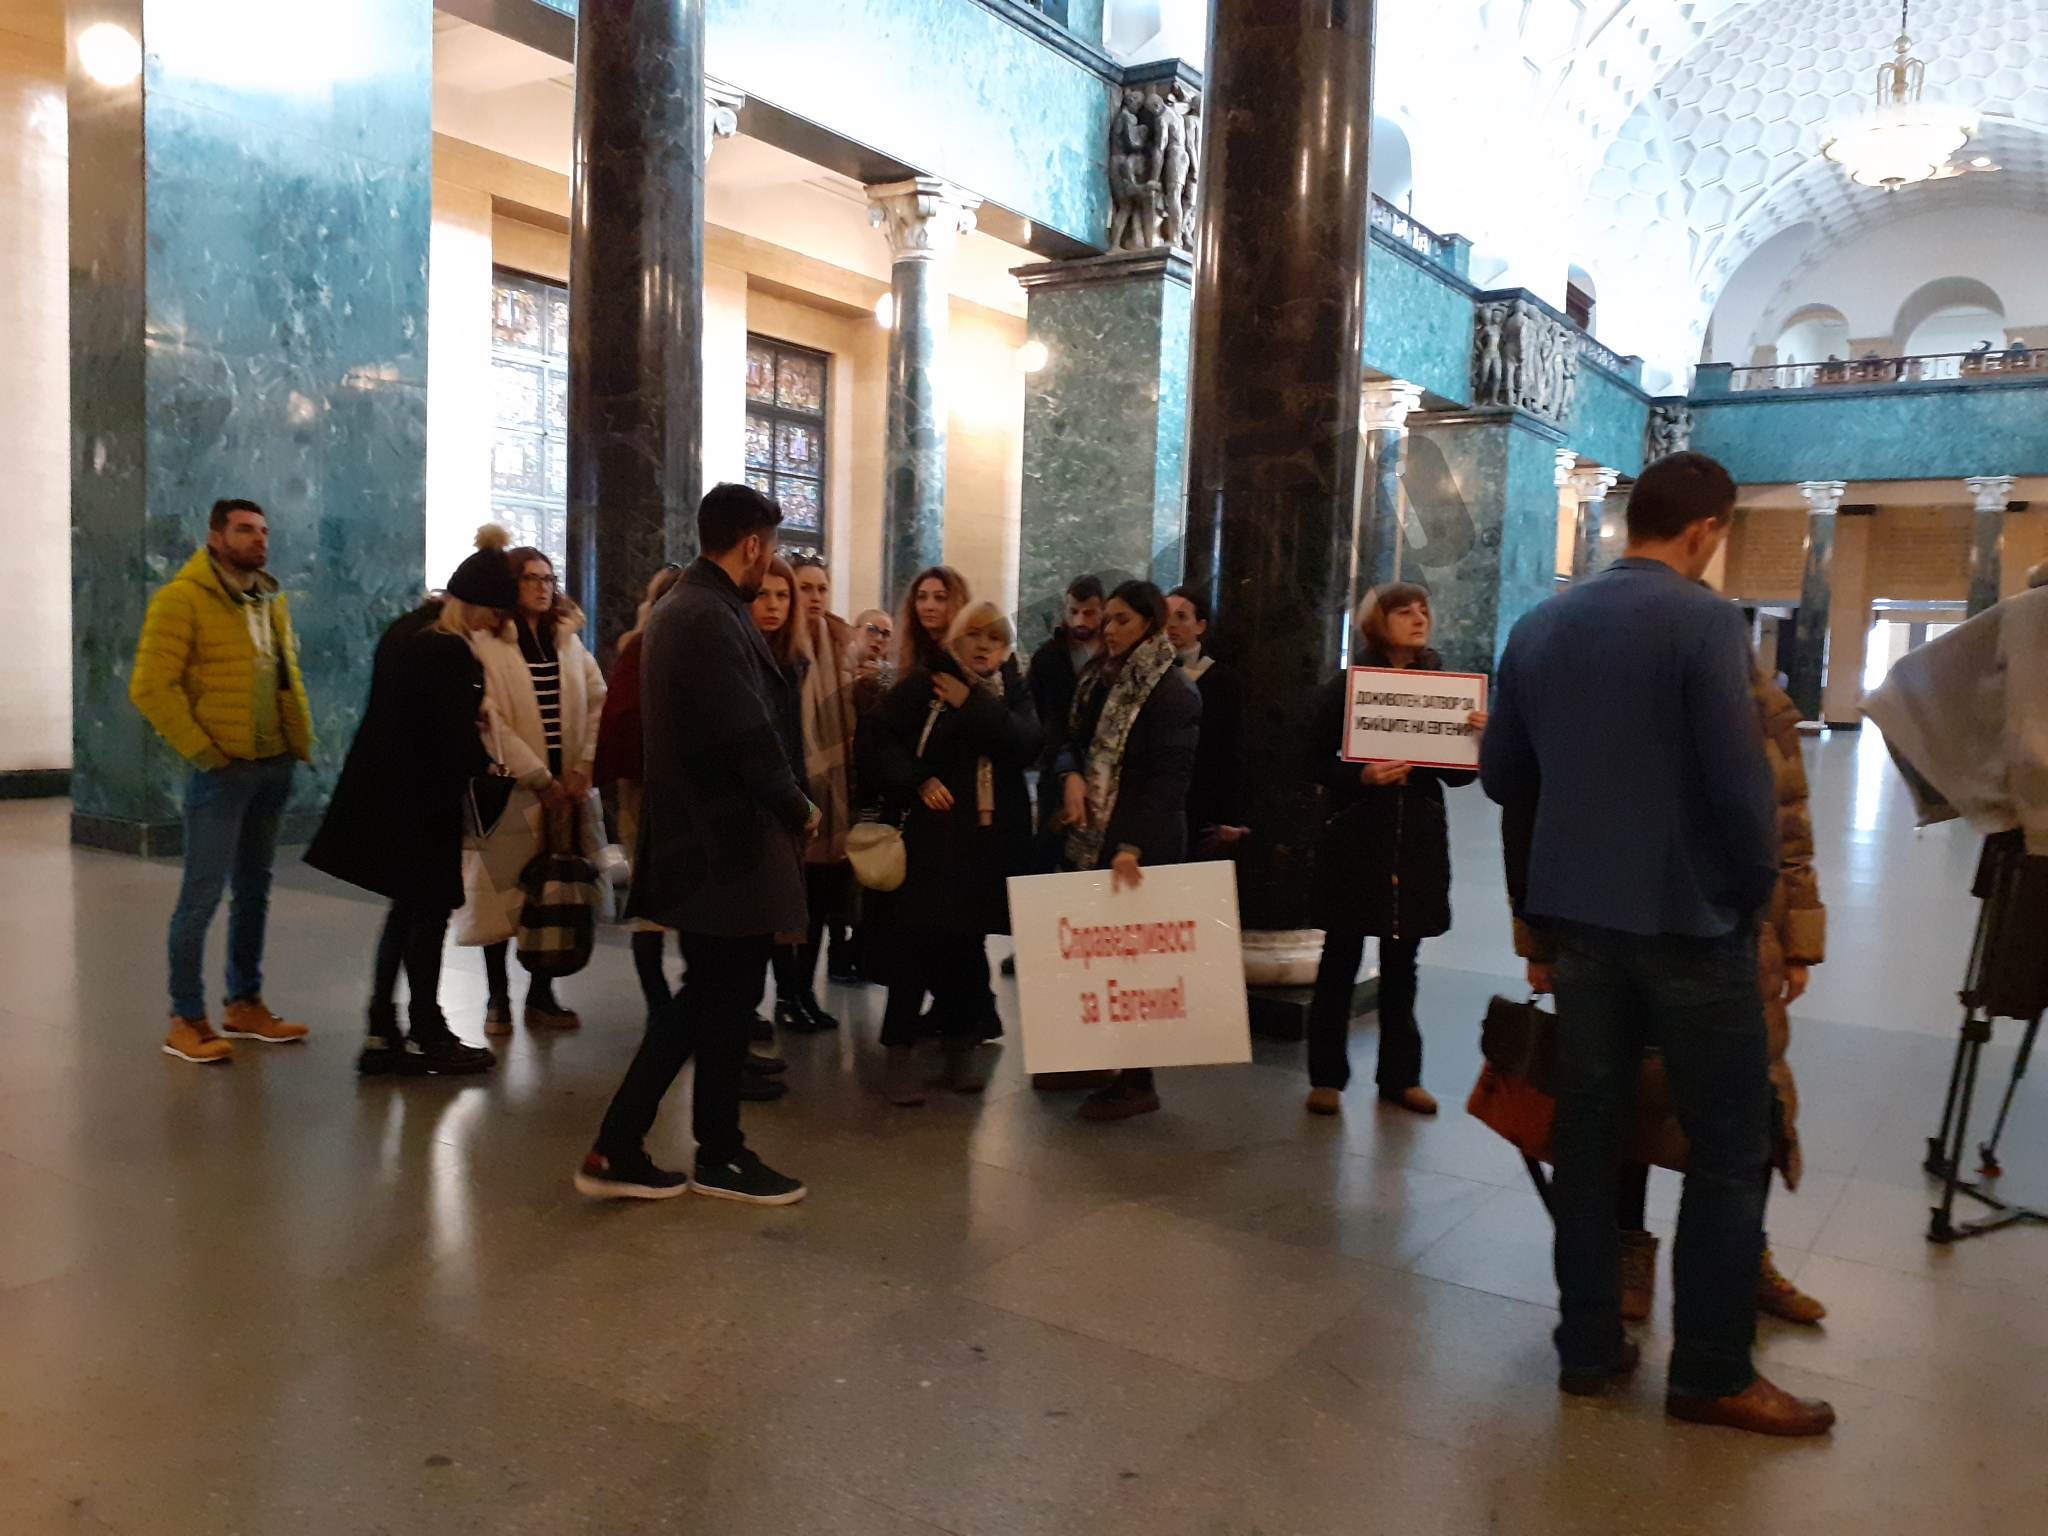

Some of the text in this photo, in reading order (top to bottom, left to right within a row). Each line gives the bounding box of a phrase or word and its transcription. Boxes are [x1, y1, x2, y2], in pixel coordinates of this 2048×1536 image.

[1355, 691, 1474, 710] ДОЖИВОТЕН ЗАТВОР ЗА
[1411, 720, 1425, 733] НА
[1058, 918, 1196, 969] Справедливост
[1080, 992, 1100, 1024] за
